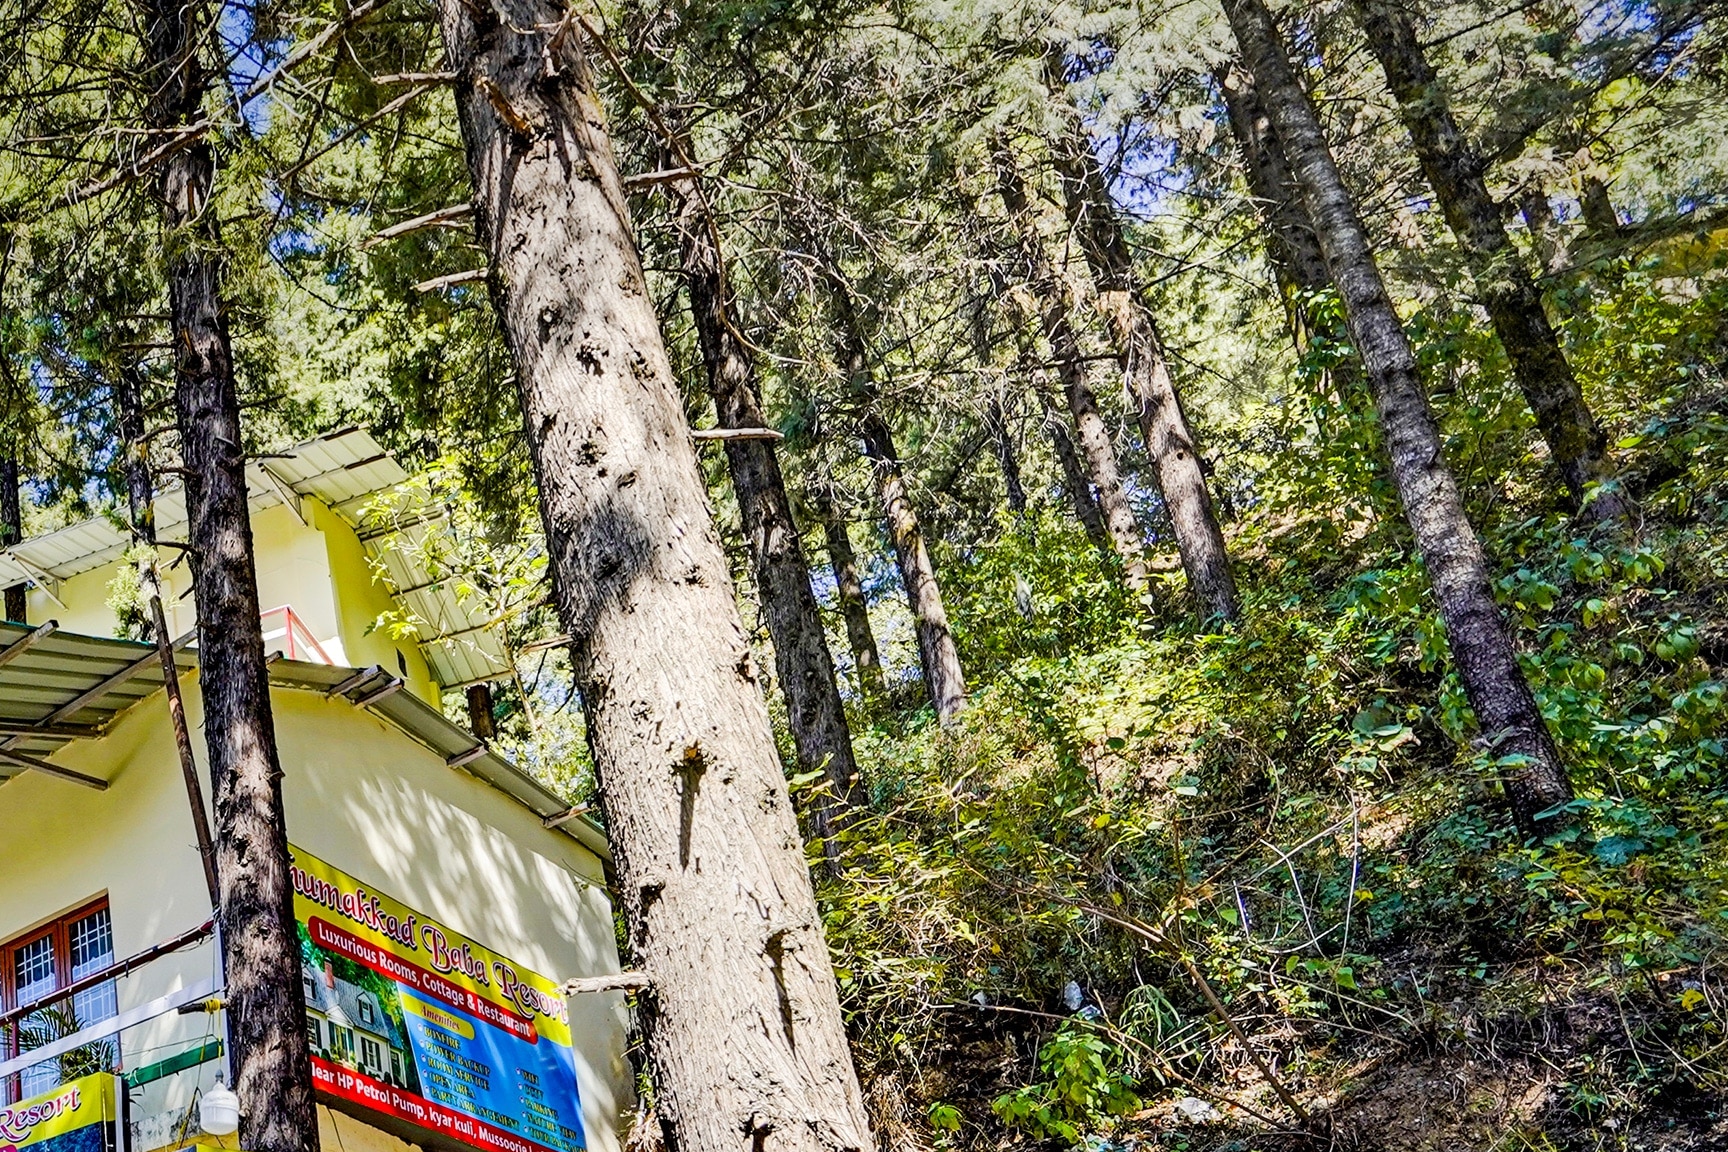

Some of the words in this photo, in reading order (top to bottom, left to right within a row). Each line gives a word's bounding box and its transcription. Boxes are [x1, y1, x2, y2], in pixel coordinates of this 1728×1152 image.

[289, 853, 417, 951] umakkad
[421, 924, 490, 988] Baba
[492, 961, 569, 1024] Resort
[318, 923, 377, 963] Luxurious
[379, 950, 421, 986] Rooms,
[422, 973, 464, 1006] Cottage
[466, 994, 476, 1010] &
[477, 1000, 530, 1037] Restaurant
[421, 1006, 460, 1031] Amenities
[424, 1027, 461, 1050] BONFIRE
[337, 1071, 354, 1090] HP
[355, 1078, 390, 1105] Petrol
[392, 1094, 428, 1121] Pump,
[429, 1107, 453, 1127] kyar
[454, 1120, 478, 1140] kuli,
